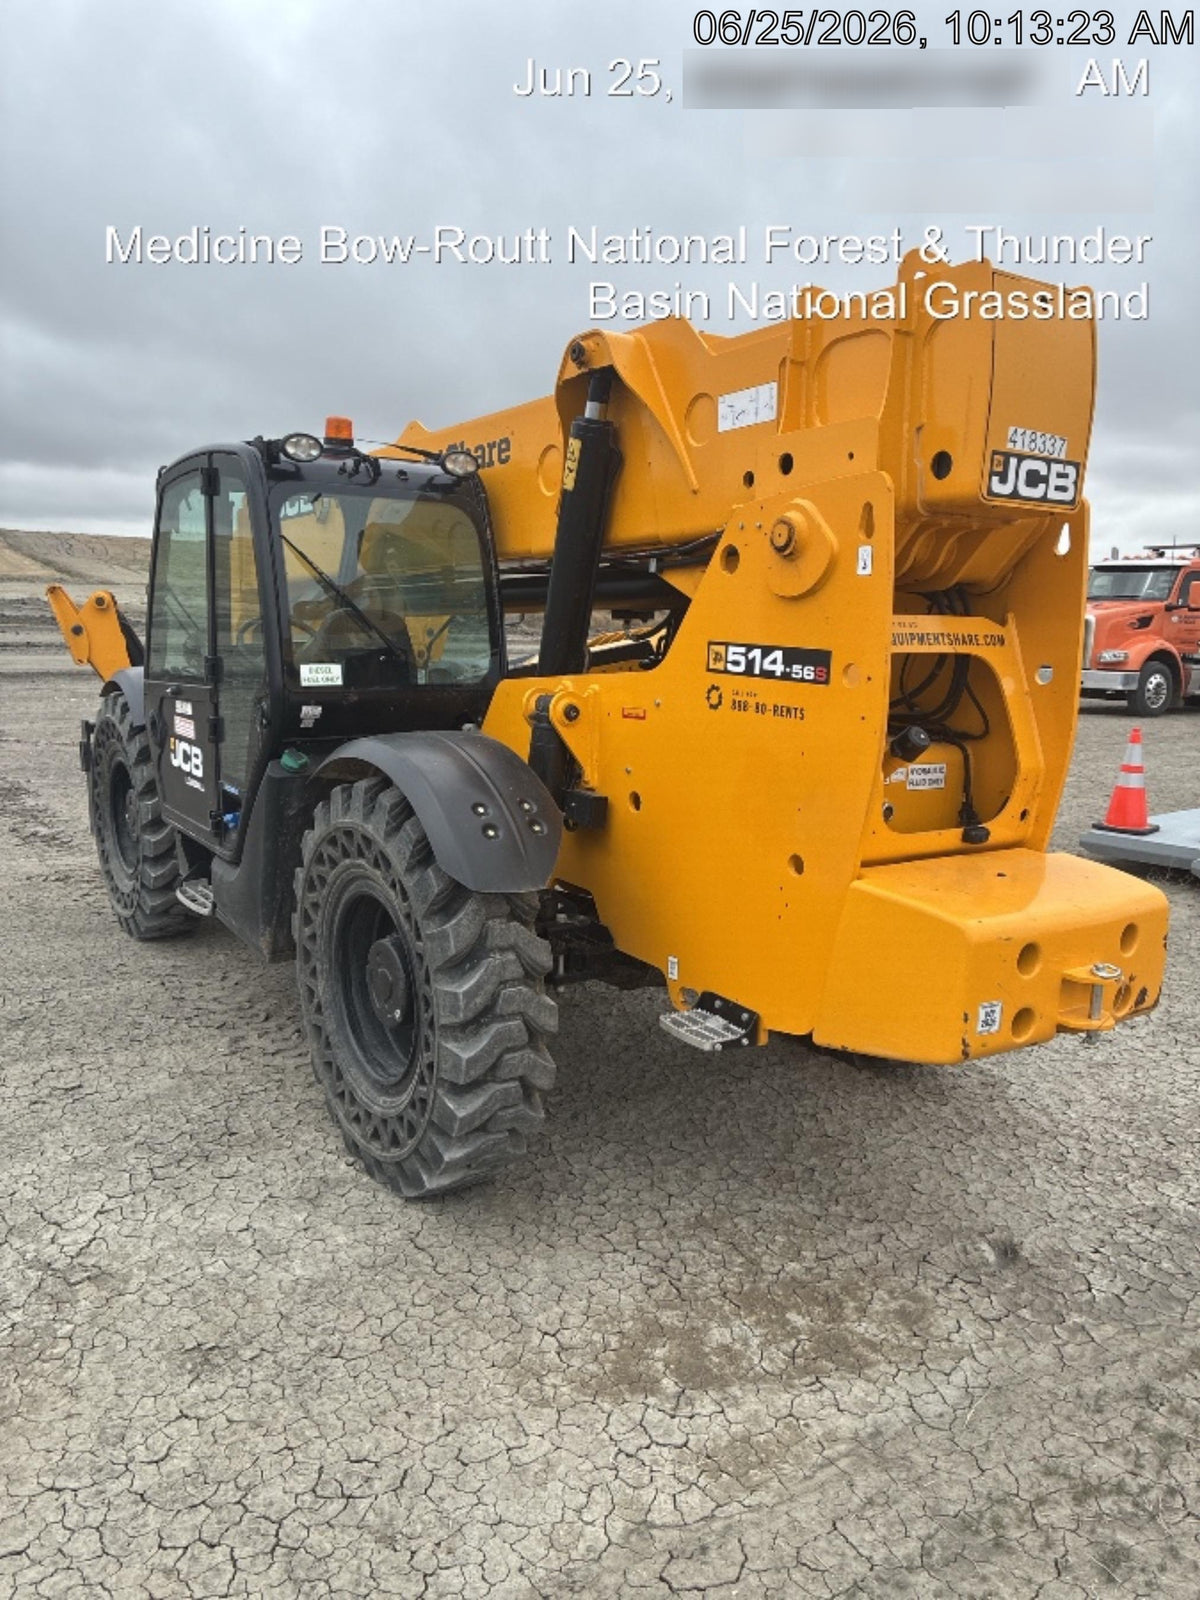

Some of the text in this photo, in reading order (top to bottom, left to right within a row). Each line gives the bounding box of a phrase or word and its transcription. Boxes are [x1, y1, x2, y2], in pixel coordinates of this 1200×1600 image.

[1008, 427, 1067, 458] 418337
[989, 455, 1077, 501] JCB
[170, 737, 204, 778] JCB
